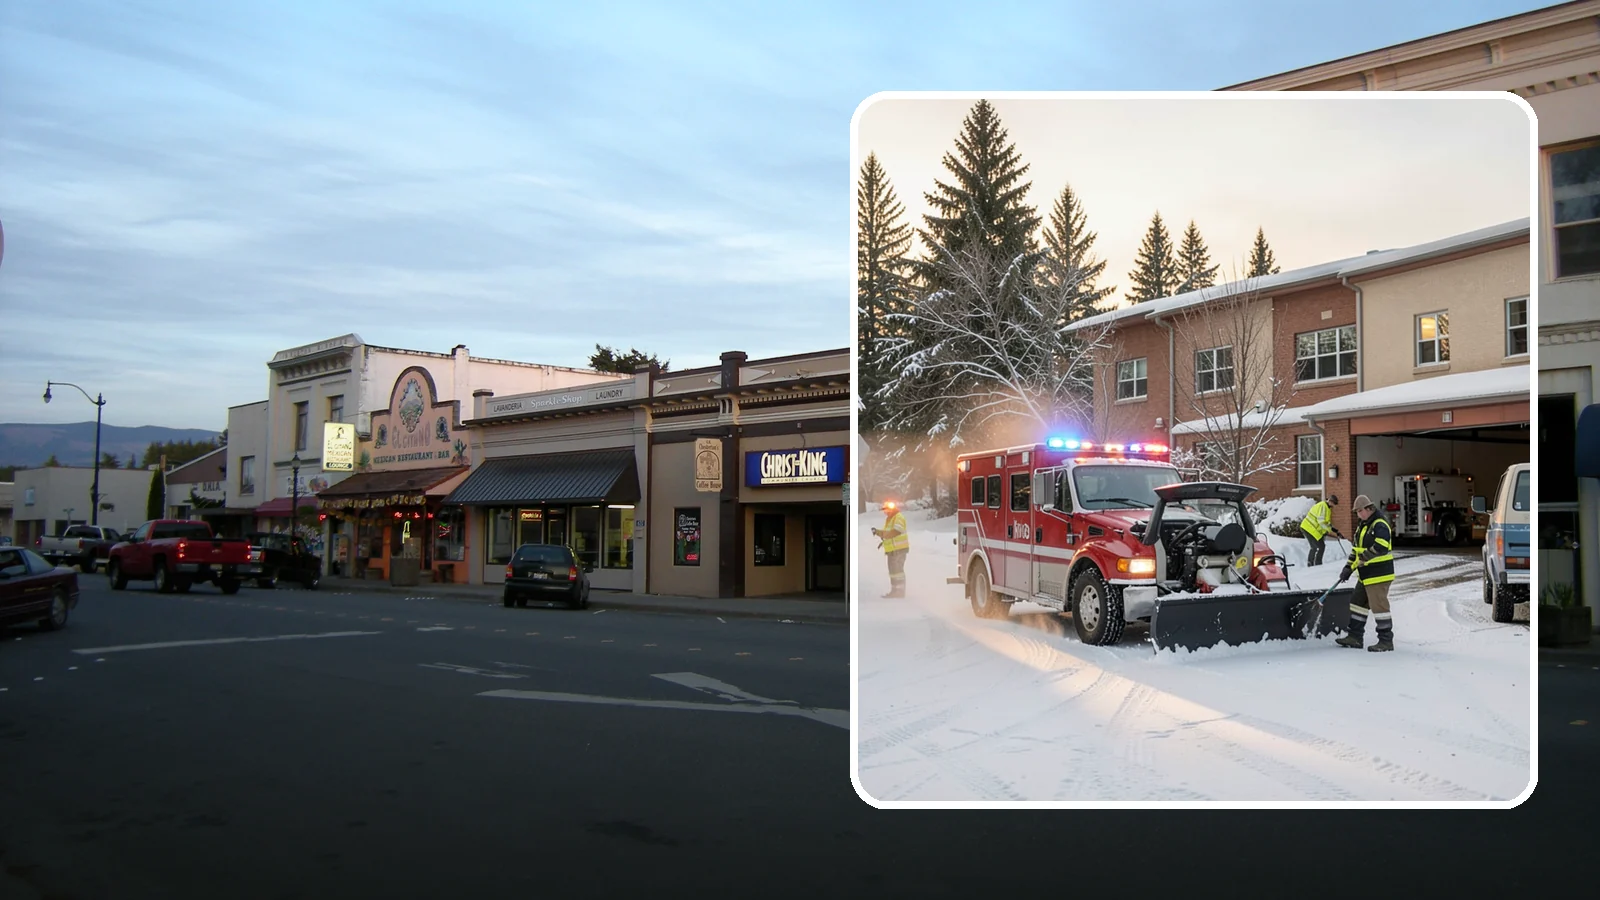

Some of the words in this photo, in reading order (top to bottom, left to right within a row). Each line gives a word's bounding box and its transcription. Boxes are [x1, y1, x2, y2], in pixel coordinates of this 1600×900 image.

[531, 399, 561, 409] Sparkle
[561, 394, 583, 405] Shop
[595, 389, 624, 400] LAUNDRY
[494, 402, 522, 412] LAVANDERIA
[373, 456, 396, 464] MEXICAN
[397, 451, 434, 462] RESTAURANT
[437, 450, 450, 460] BAR
[760, 452, 797, 478] CHRIST
[799, 449, 828, 477] KING
